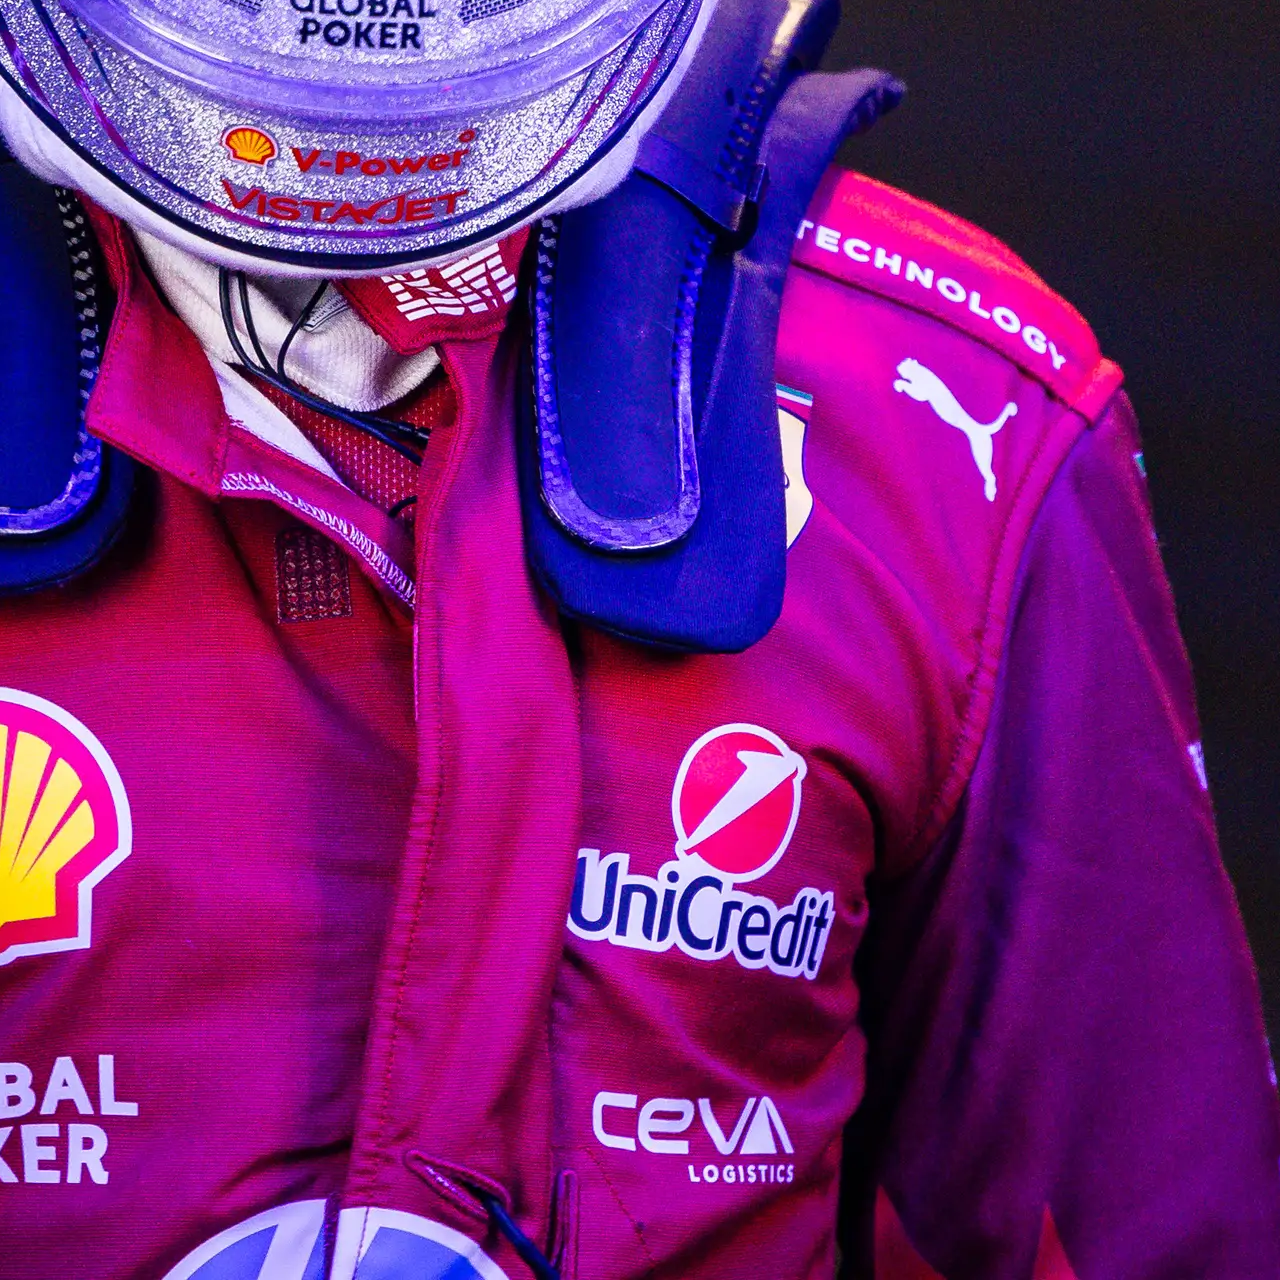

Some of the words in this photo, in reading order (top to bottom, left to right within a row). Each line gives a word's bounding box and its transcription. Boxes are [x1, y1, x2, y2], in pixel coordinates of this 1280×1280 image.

[299, 20, 421, 50] POKER
[290, 147, 470, 177] V-Power
[796, 220, 1067, 371] TECHNOLOGY
[570, 856, 831, 973] UniCredit
[688, 1164, 794, 1184] LOGISTICS
